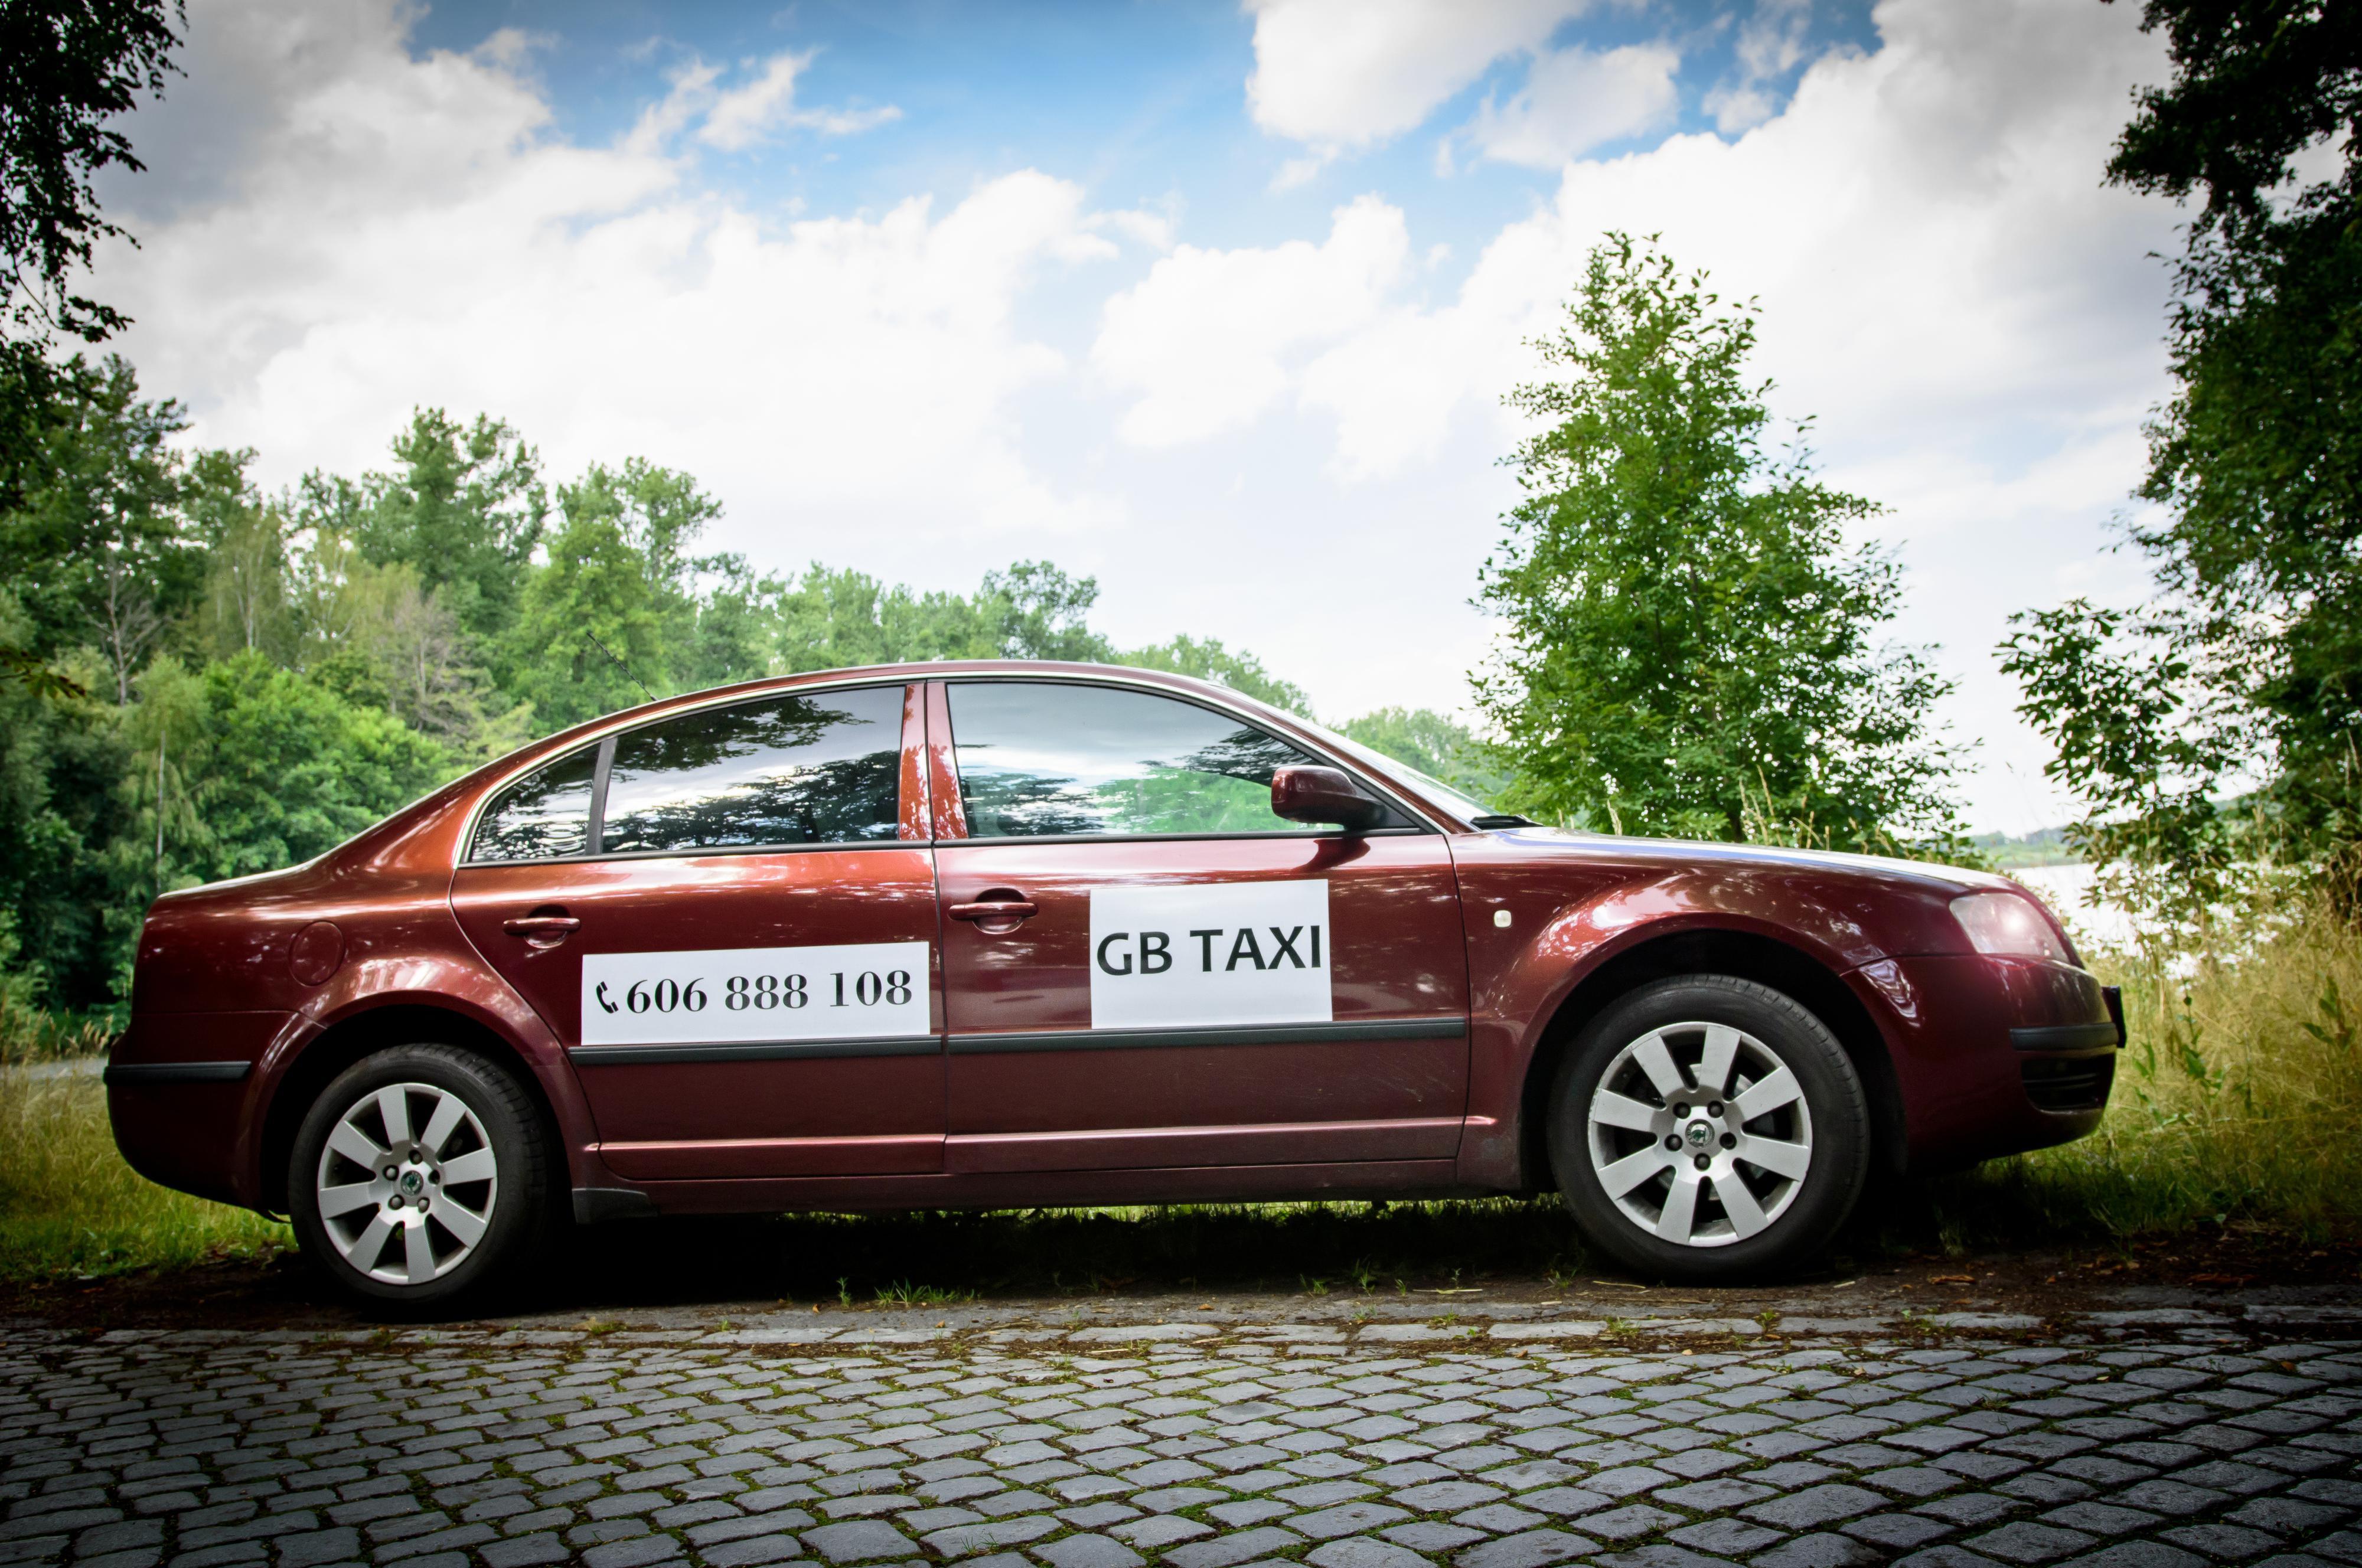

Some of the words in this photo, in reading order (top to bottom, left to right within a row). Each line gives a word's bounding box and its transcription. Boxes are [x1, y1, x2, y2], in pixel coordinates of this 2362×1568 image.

[1097, 932, 1173, 976] GB
[1189, 925, 1321, 972] TAXI
[627, 978, 707, 1014] 606
[725, 974, 808, 1011] 888
[830, 970, 912, 1007] 108
